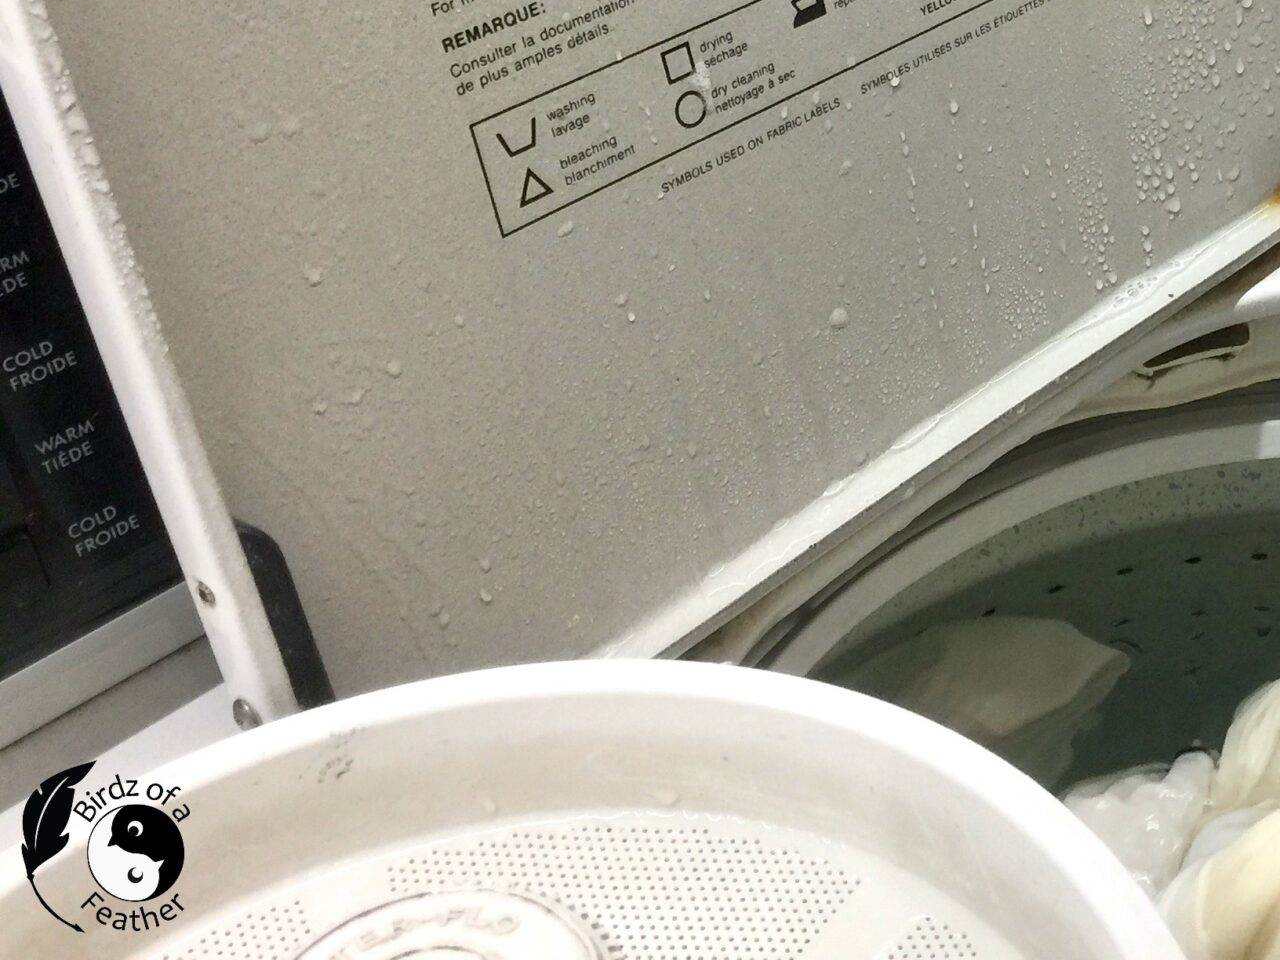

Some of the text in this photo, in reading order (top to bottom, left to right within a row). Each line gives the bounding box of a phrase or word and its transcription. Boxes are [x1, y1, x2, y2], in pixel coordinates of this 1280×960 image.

[441, 1, 546, 53] REMARQUE:
[699, 31, 733, 53] drying
[703, 42, 748, 68] séchage
[546, 93, 595, 121] washing
[551, 113, 590, 137] lavage
[559, 136, 617, 169] bleaching
[661, 97, 840, 193] SYMBOLS USED ON FABRIC LABELS
[564, 144, 635, 185] blanchiment
[2, 340, 54, 372] COLD
[9, 351, 78, 392] FROIDE
[34, 419, 95, 455] WARM
[41, 441, 94, 475] TIÈDE
[68, 505, 117, 539] COLD
[74, 514, 140, 558] FROIDE
